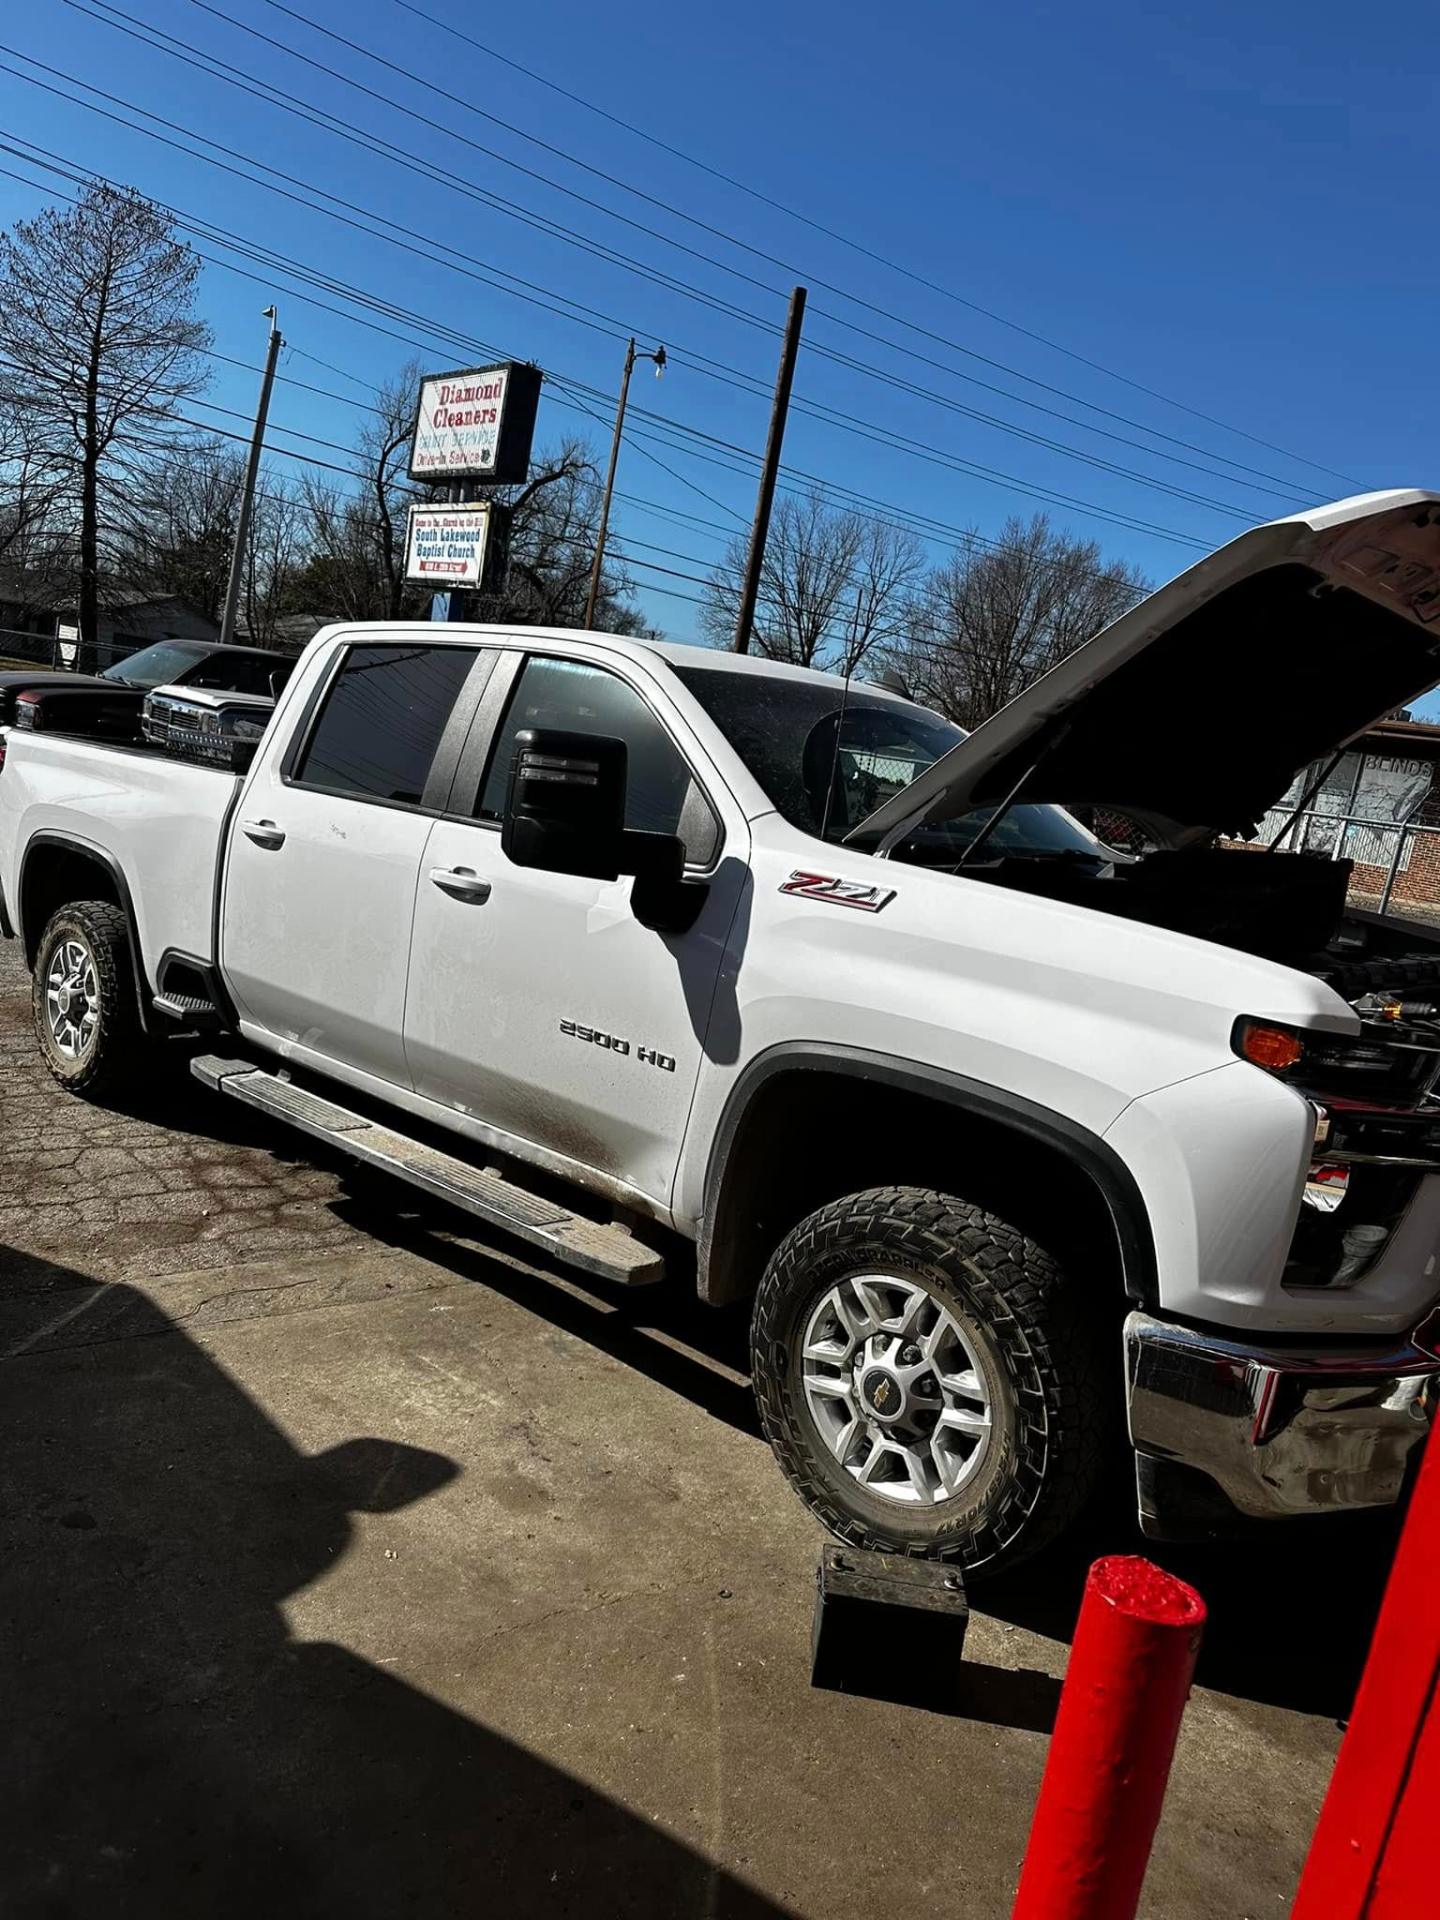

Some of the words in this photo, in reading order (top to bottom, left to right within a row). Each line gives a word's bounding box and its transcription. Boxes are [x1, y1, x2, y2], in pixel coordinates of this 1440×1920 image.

[439, 377, 503, 406] Diamond
[433, 407, 497, 429] Cleaners
[449, 449, 480, 465] Service
[415, 528, 437, 541] South
[440, 527, 480, 542] Lakewood
[416, 543, 445, 560] Baptist
[447, 543, 475, 558] Church
[1365, 754, 1434, 778] BLINDS
[778, 869, 898, 914] Z71
[559, 1017, 630, 1056] 2500
[637, 1045, 676, 1073] HD
